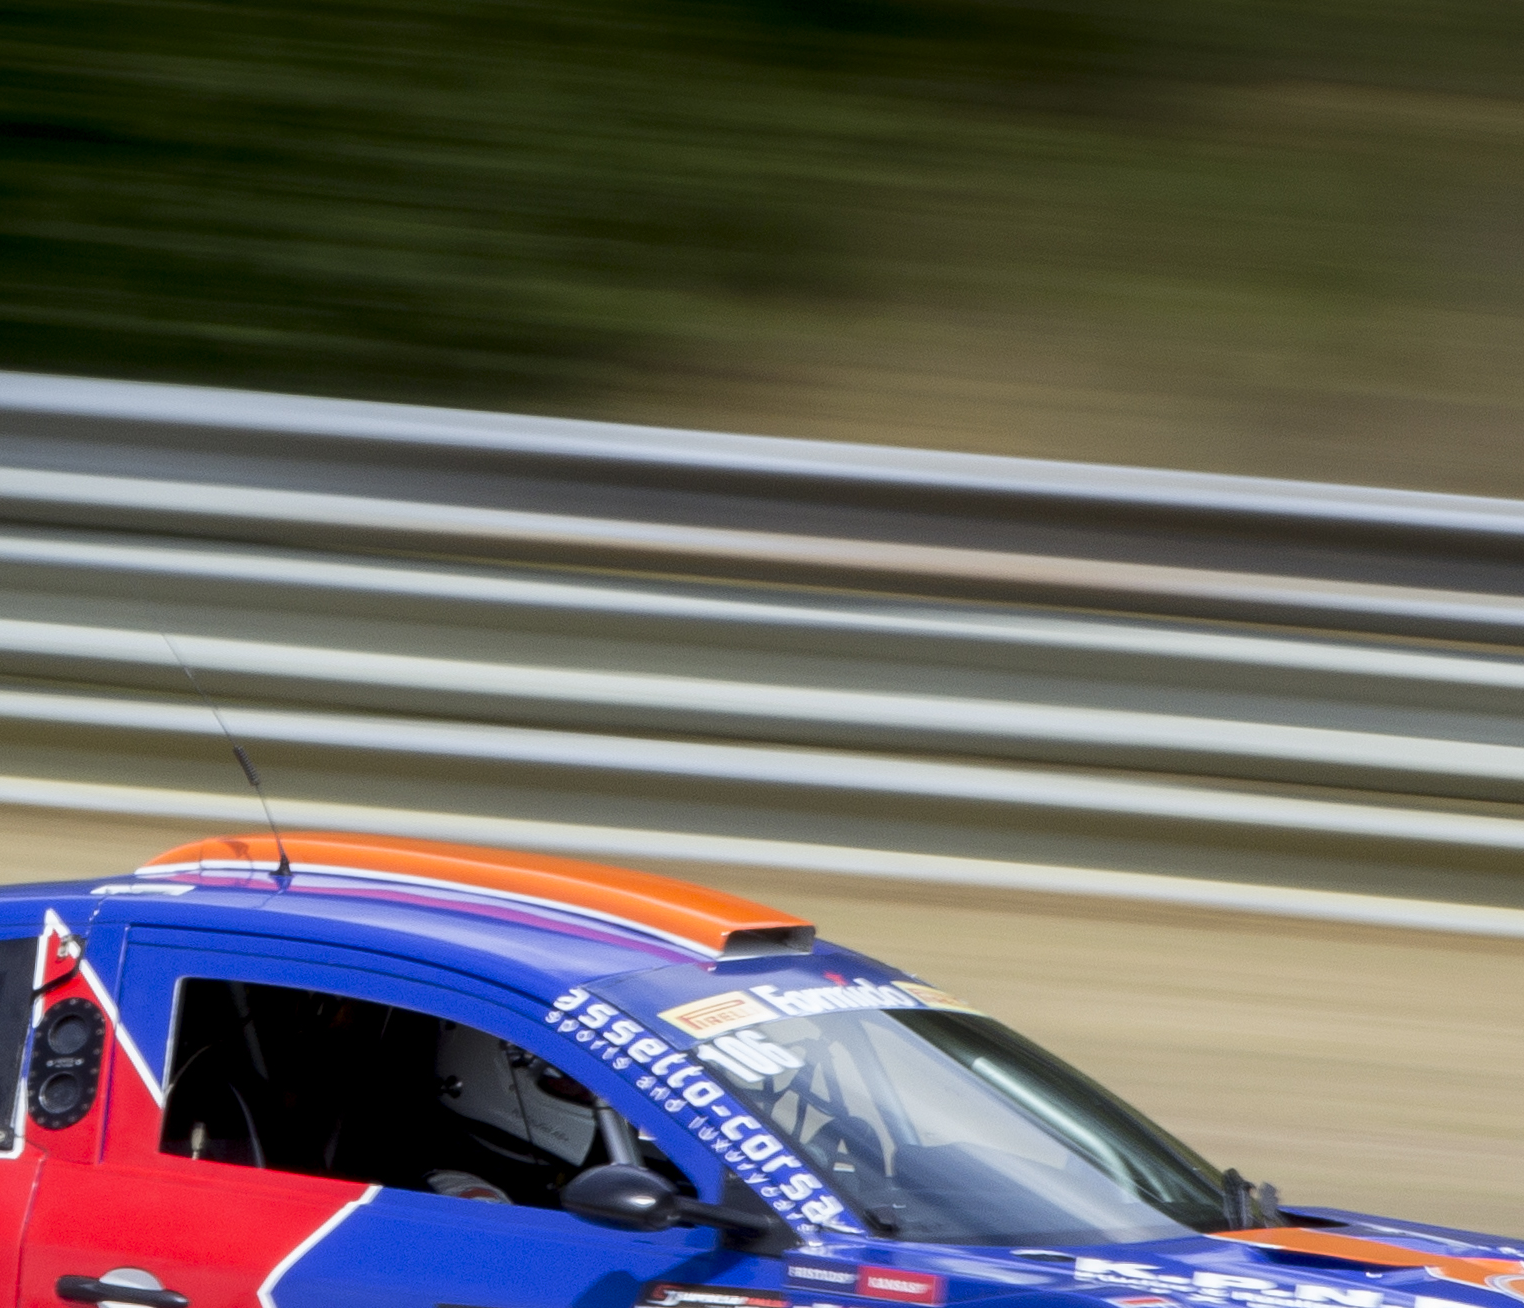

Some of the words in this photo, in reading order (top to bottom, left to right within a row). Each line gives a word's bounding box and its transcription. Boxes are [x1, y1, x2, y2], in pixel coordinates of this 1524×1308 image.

[544, 1010, 633, 1070] sports
[636, 1075, 687, 1112] and
[553, 987, 844, 1224] assetto-corsa
[697, 1029, 805, 1083] 106
